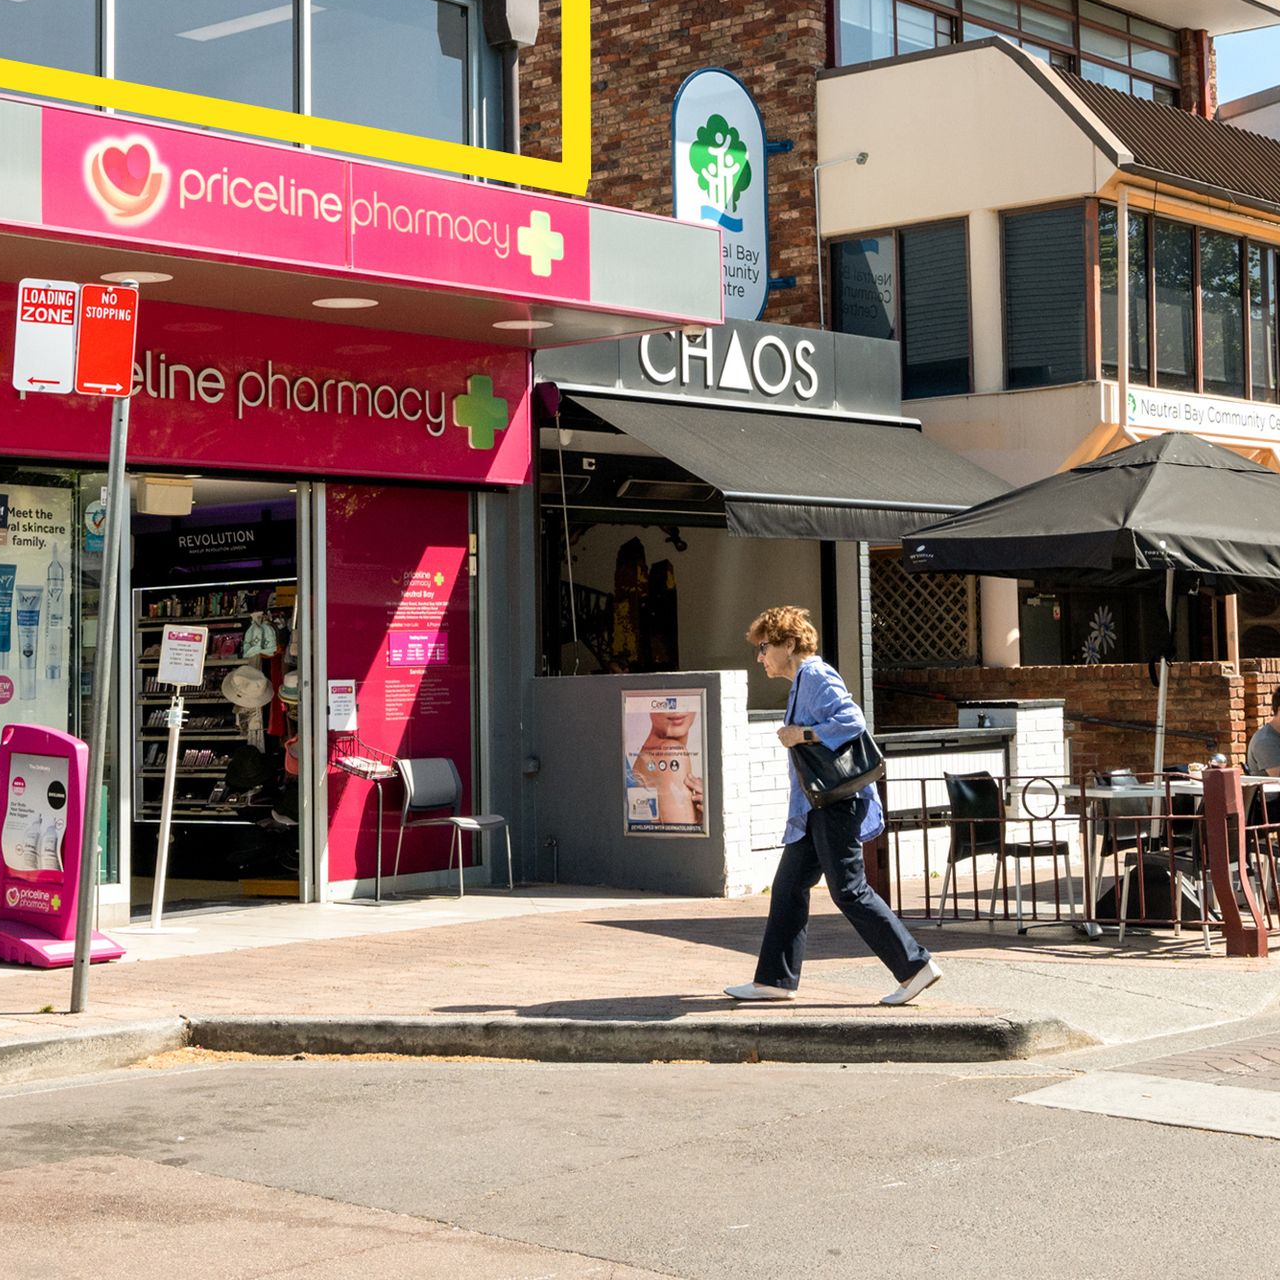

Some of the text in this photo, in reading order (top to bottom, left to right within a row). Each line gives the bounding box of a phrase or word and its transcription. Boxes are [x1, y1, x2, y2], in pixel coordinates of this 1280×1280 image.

[179, 166, 511, 260] priceline pharmacy
[736, 244, 760, 265] Bay
[723, 265, 760, 284] unity
[23, 289, 74, 306] LOADING
[101, 293, 118, 305] NO
[21, 306, 73, 324] ZONE
[85, 307, 131, 321] STOPPING
[131, 349, 447, 437] eline pharmacy
[1140, 398, 1181, 420] Neutral
[1184, 403, 1205, 425] Bay
[1207, 406, 1266, 432] Community
[7, 506, 53, 520] Meet the
[22, 521, 66, 535] skincare
[12, 535, 48, 550] family.
[178, 529, 255, 548] REVOLUTION
[20, 888, 50, 900] priceline
[20, 897, 49, 913] pharmacy
